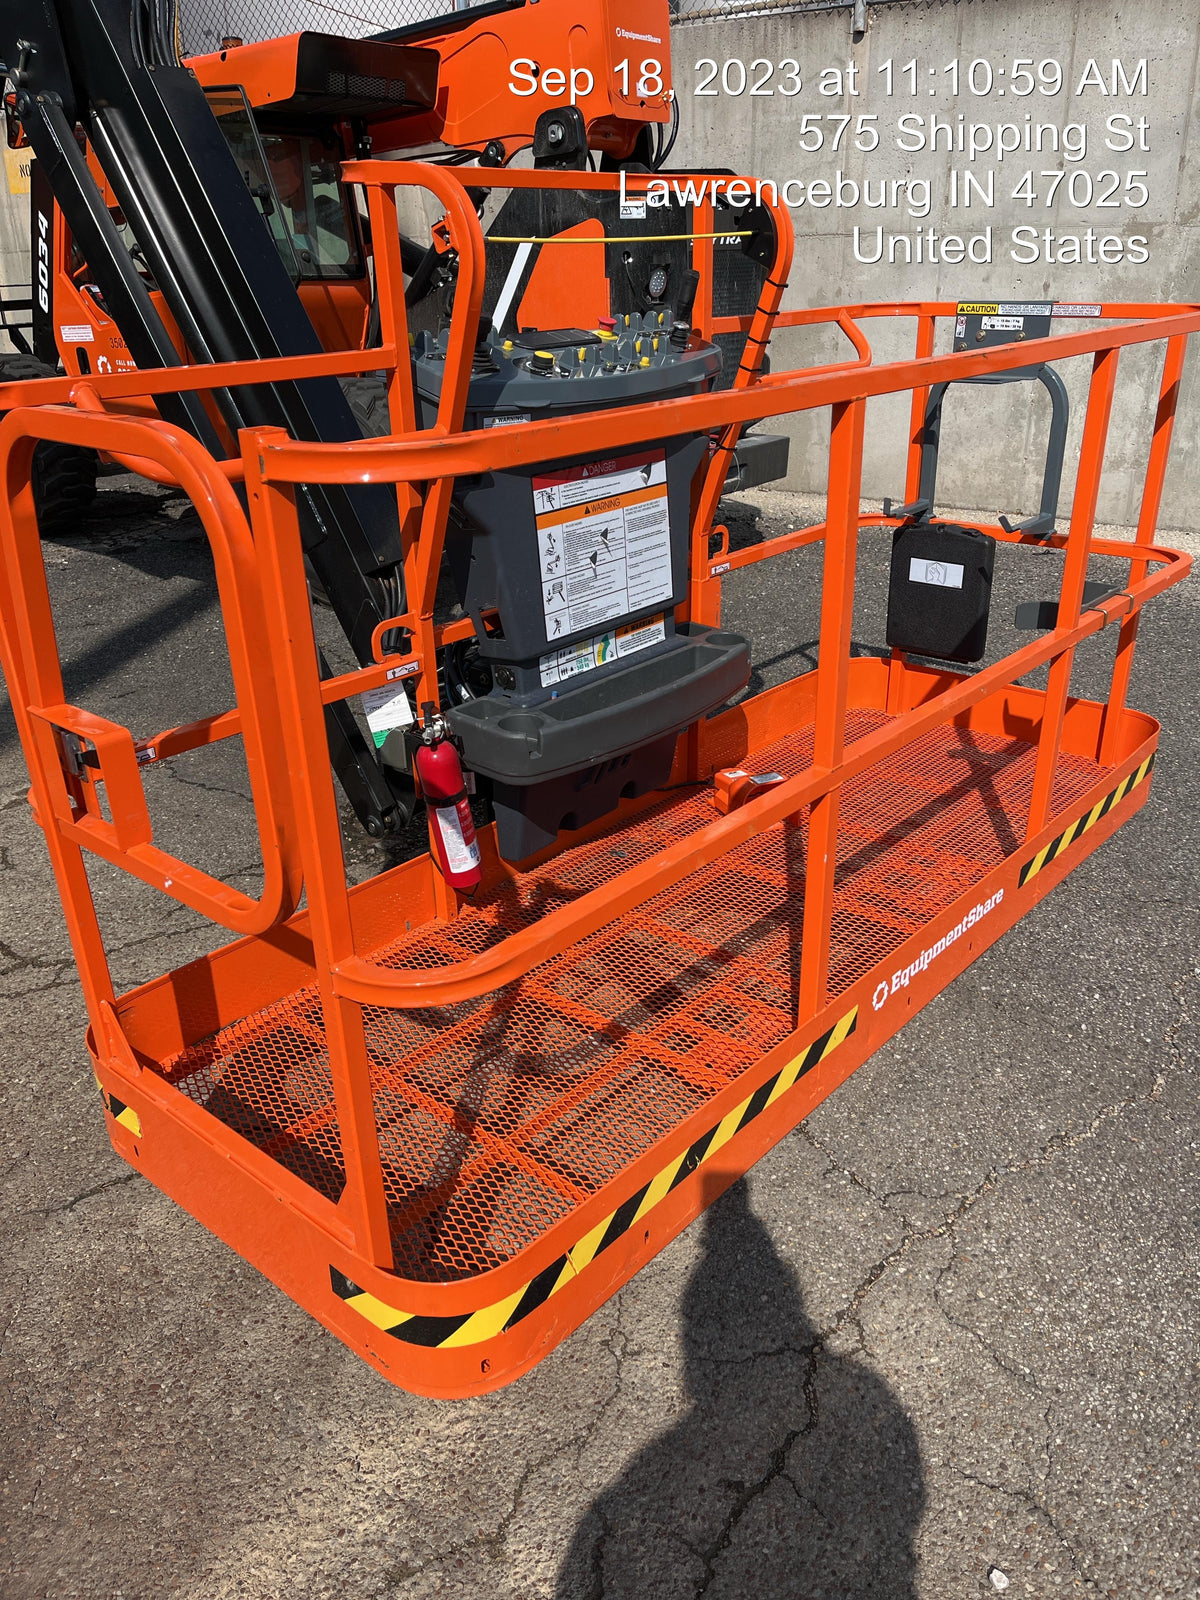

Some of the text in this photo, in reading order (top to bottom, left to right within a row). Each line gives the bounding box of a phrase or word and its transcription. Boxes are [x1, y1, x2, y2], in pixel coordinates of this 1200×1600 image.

[621, 29, 662, 44] EquipmentShare
[37, 210, 49, 314] 6034
[965, 305, 998, 313] CAUTION
[497, 415, 524, 424] WARNING
[588, 461, 617, 476] DANGER
[590, 498, 621, 513] WARNING
[890, 888, 1004, 995] EquipmentShare
